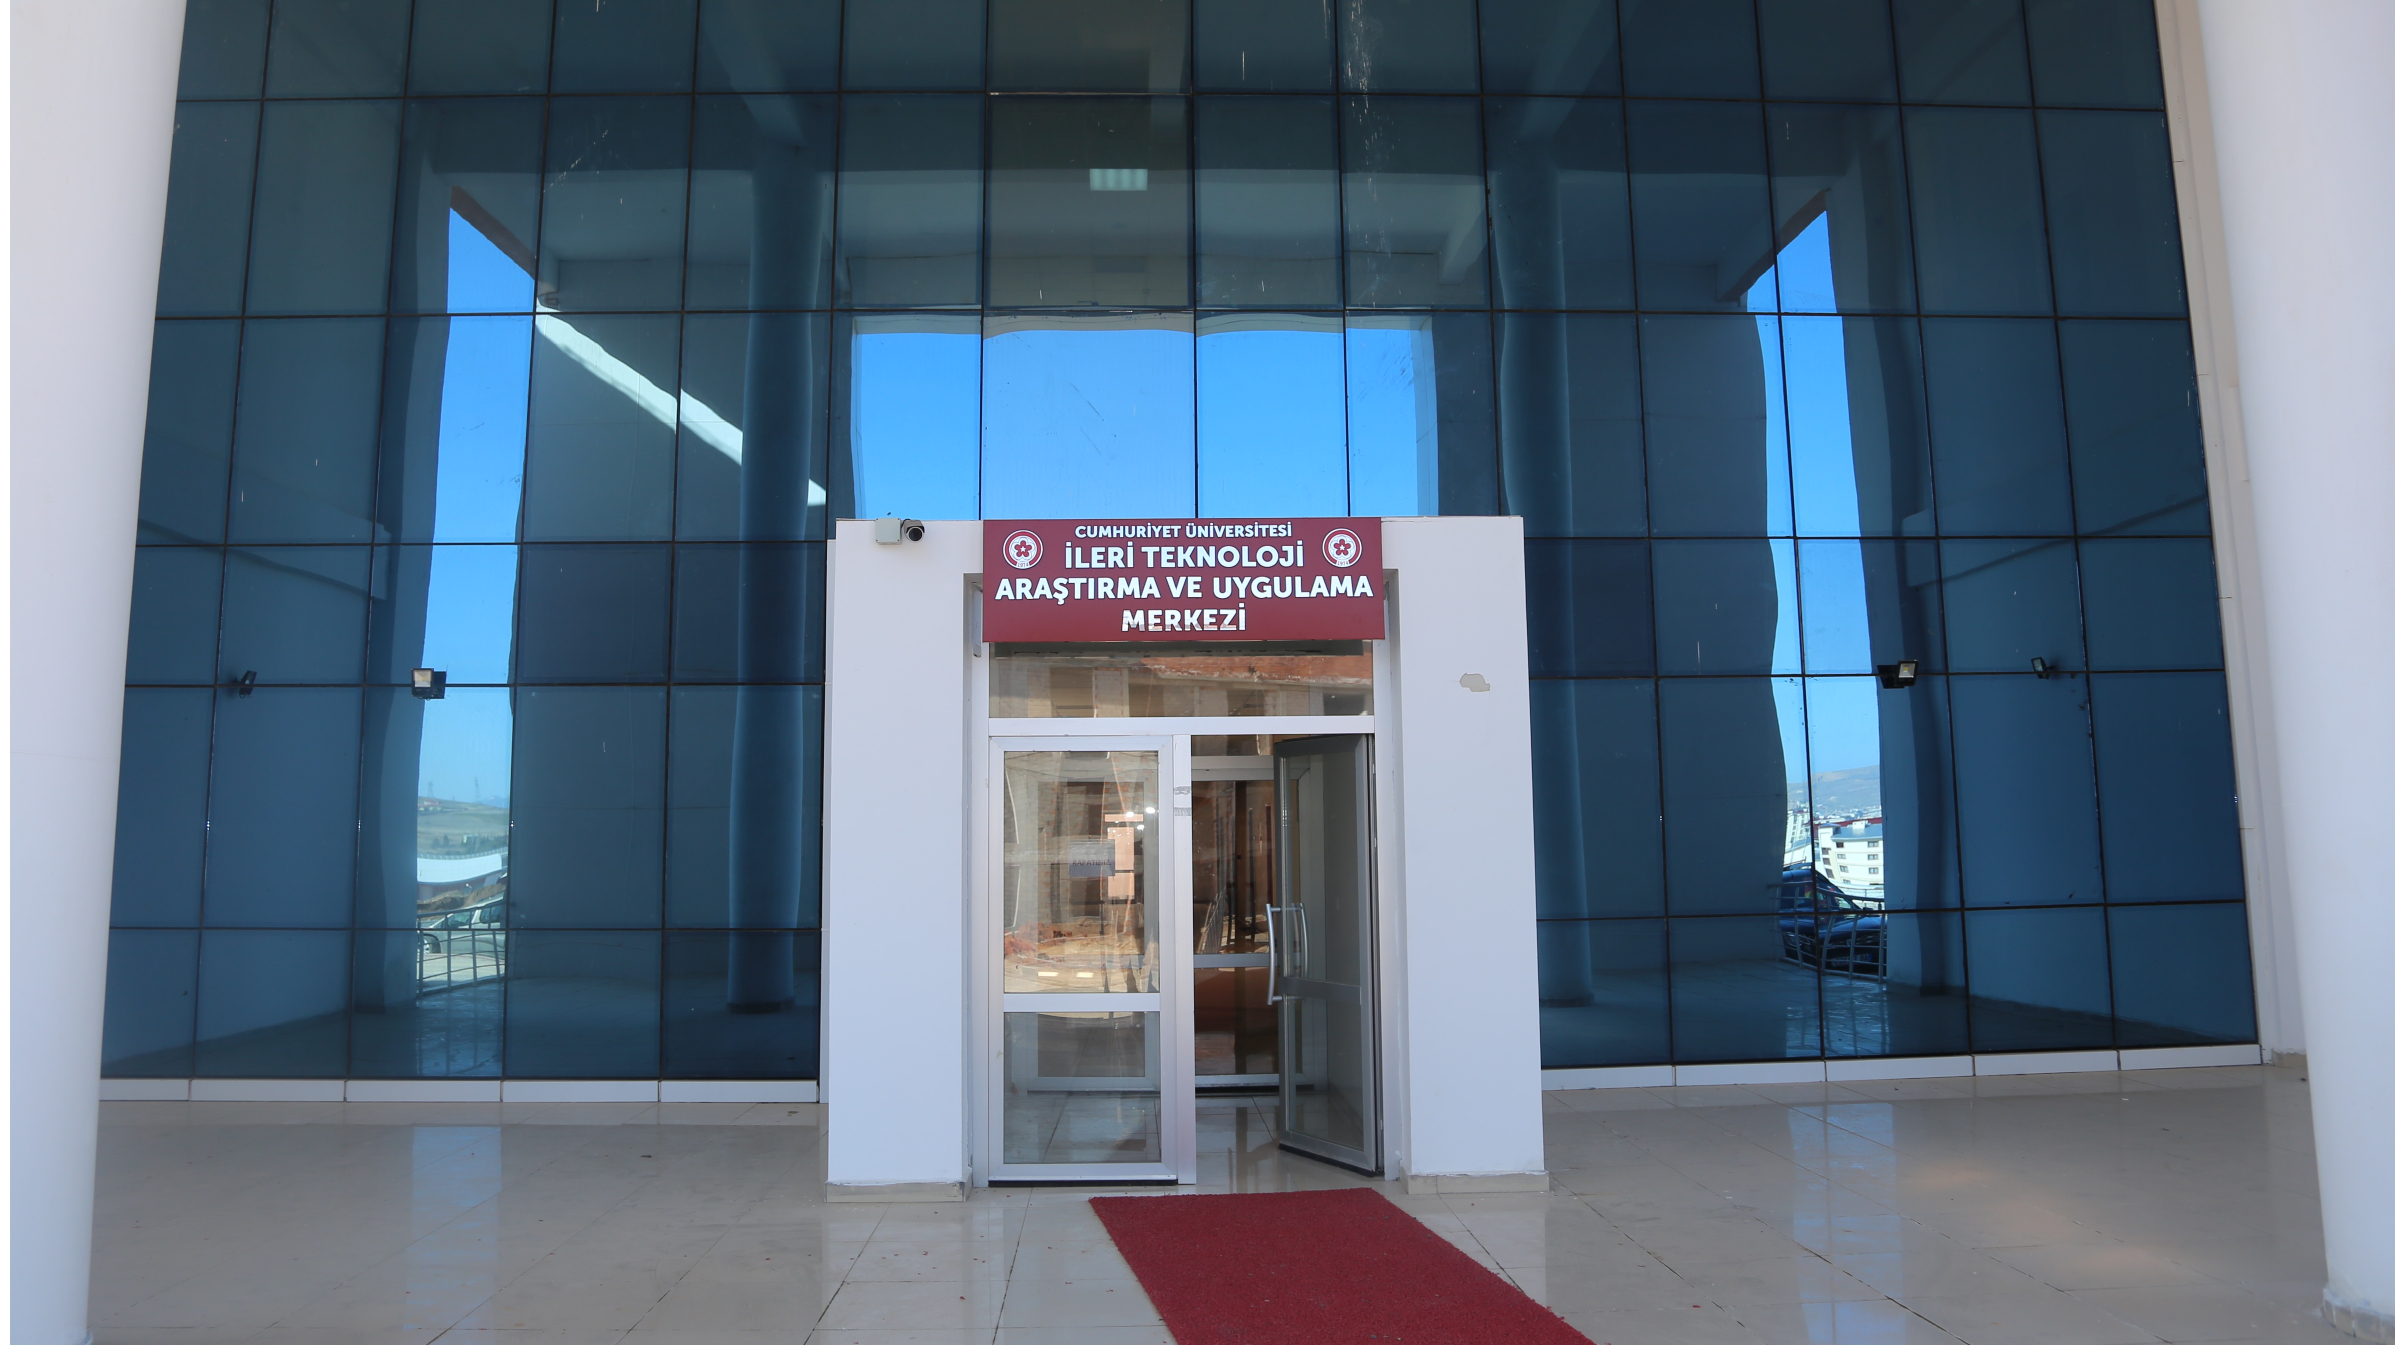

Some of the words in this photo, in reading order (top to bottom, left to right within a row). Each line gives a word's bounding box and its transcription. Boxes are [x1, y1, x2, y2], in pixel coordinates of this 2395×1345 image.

[1074, 522, 1181, 539] CUMHURİYET
[1185, 521, 1293, 538] ÜNİVERSİTESİ
[1064, 541, 1135, 569] İLERİ
[1140, 539, 1305, 568] TEKNOLOJİ
[994, 577, 1163, 605] ARAŞTIRMA
[1164, 576, 1204, 599] VE
[1212, 575, 1374, 599] UYGULAMA
[1121, 602, 1247, 632] MERKEZİ
